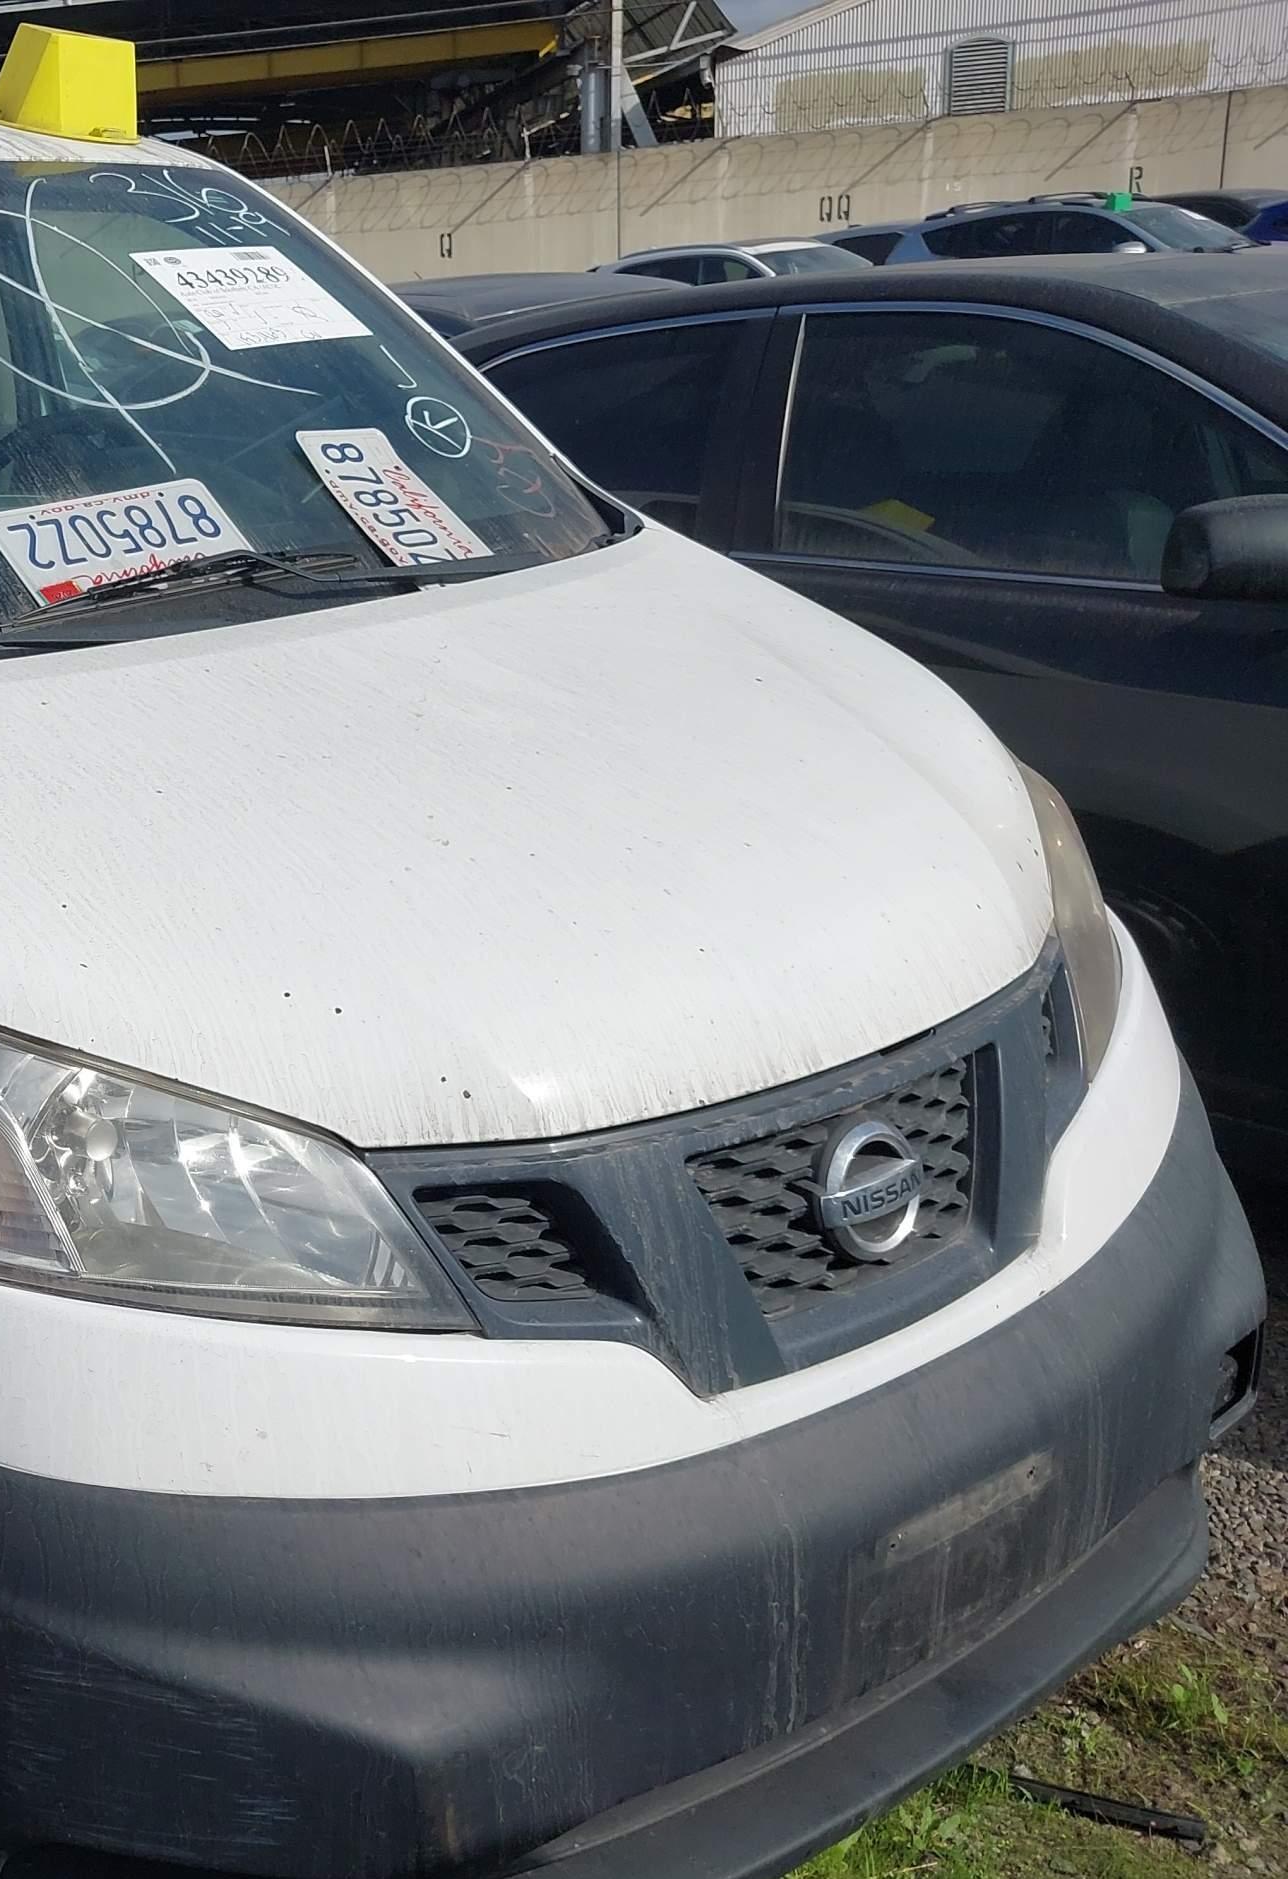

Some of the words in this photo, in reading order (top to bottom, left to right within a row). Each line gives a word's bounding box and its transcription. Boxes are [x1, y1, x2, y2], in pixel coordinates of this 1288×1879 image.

[1129, 166, 1143, 193] R
[176, 265, 290, 289] 43439289
[39, 491, 151, 517] dmv.ca.gov
[328, 479, 410, 565] dmv.ca.gov
[382, 467, 474, 559] California
[840, 1172, 921, 1219] NISSAN
